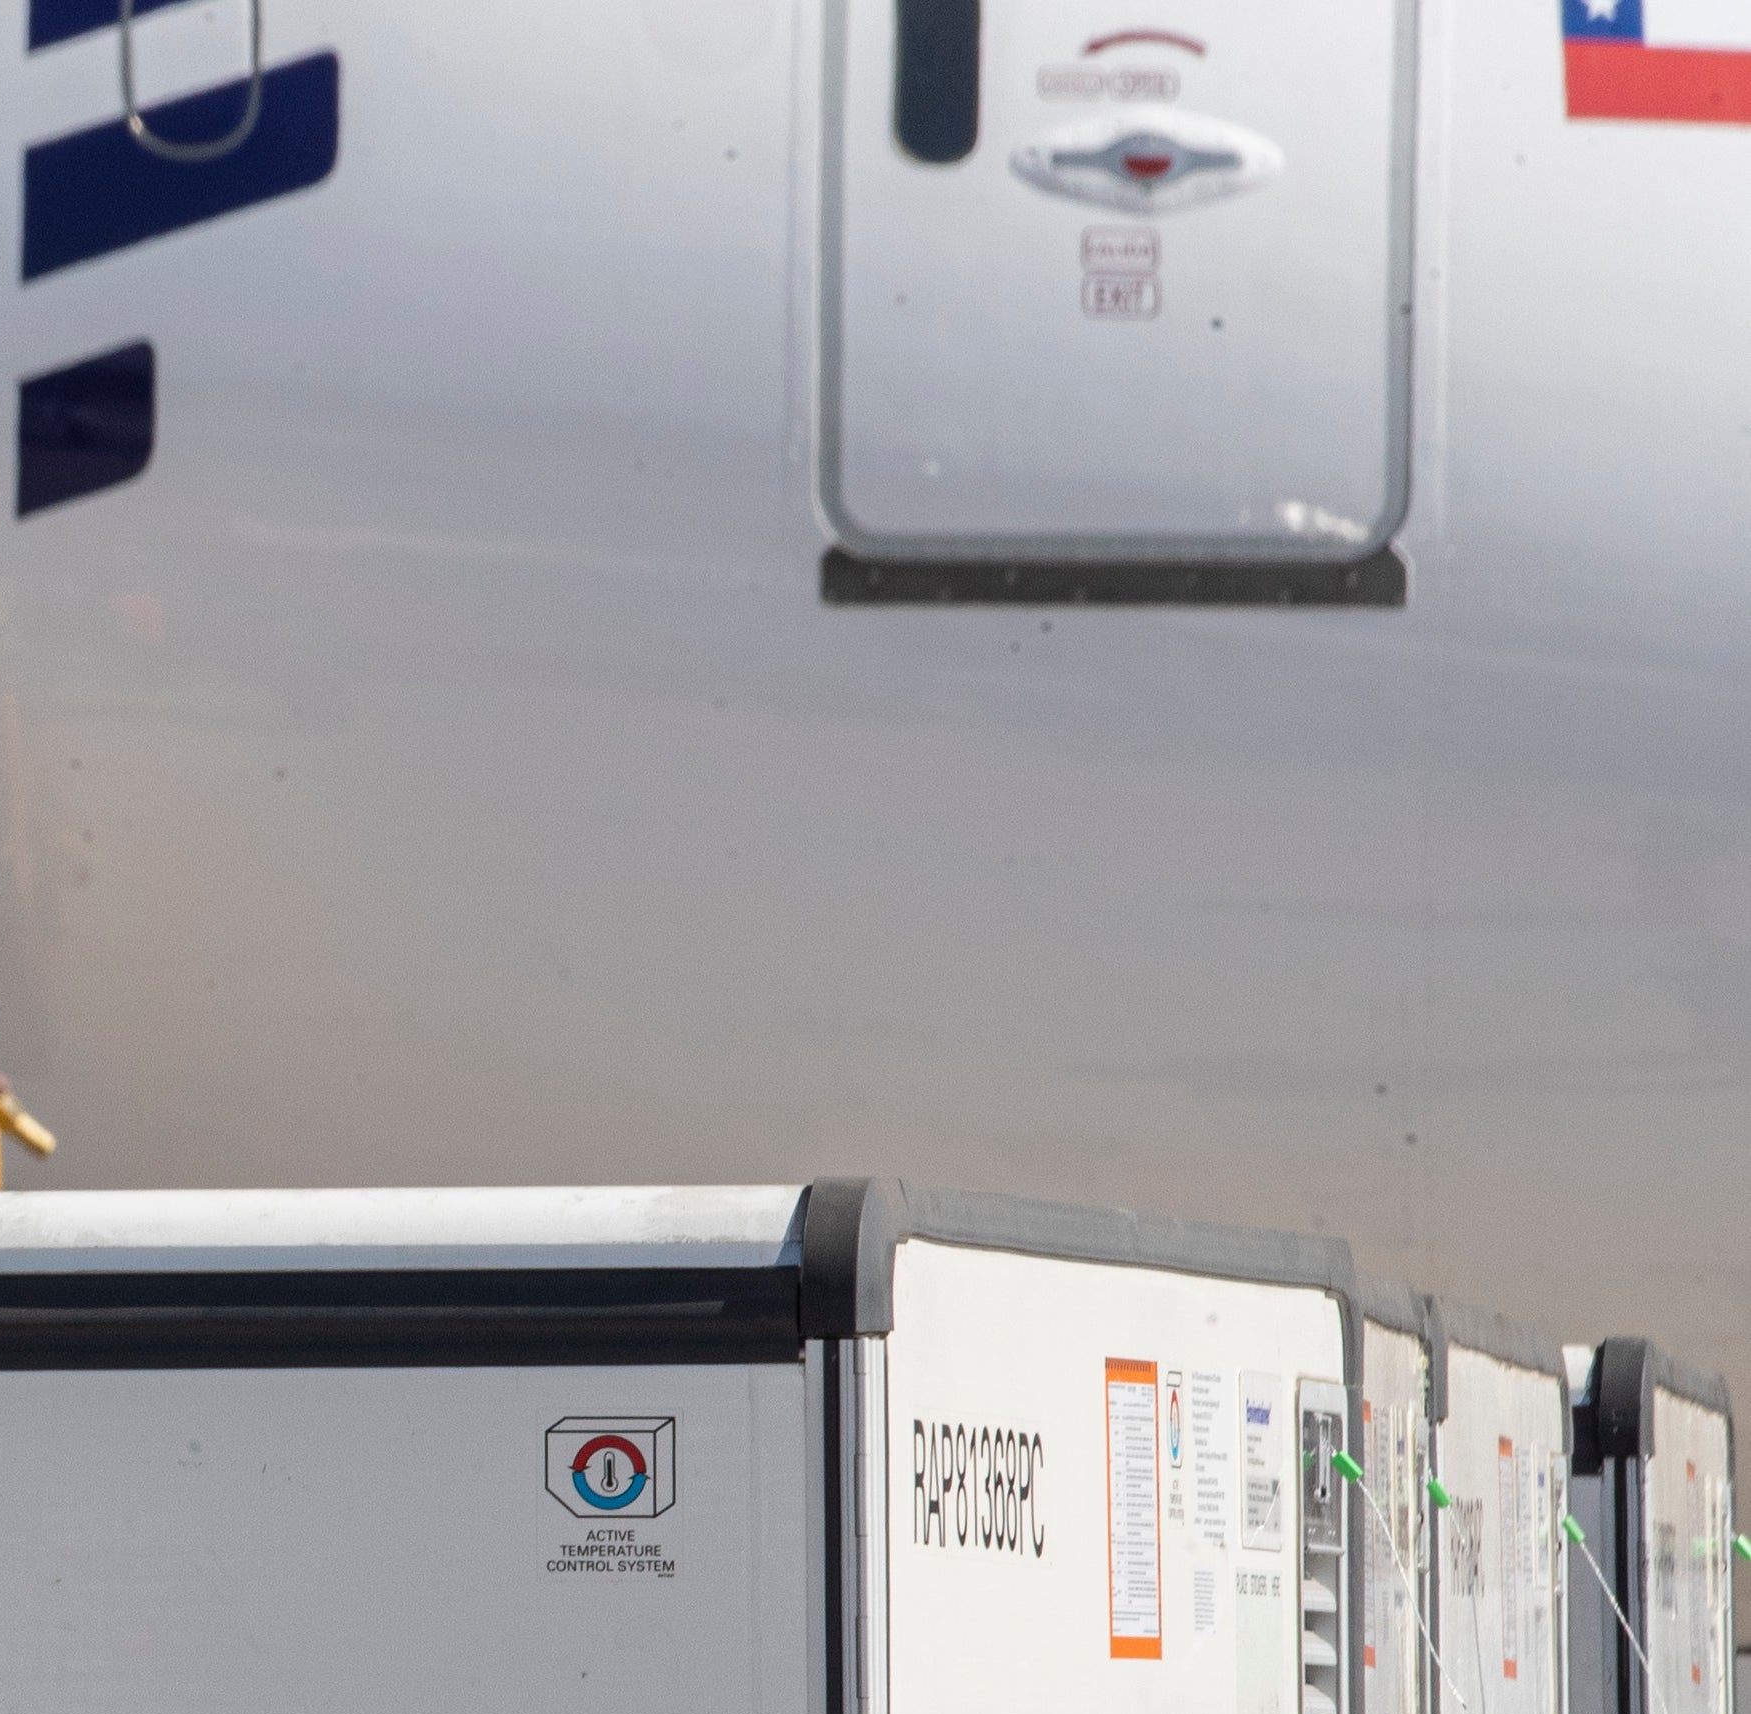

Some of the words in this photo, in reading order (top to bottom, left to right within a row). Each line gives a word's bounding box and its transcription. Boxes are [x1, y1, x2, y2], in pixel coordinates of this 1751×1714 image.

[913, 1418, 1045, 1558] RAP81368PC
[586, 1530, 635, 1542] ACTIVE
[560, 1545, 661, 1557] TEMPERATURE
[547, 1560, 613, 1572] CONTROL
[618, 1560, 675, 1572] SYSTEM
